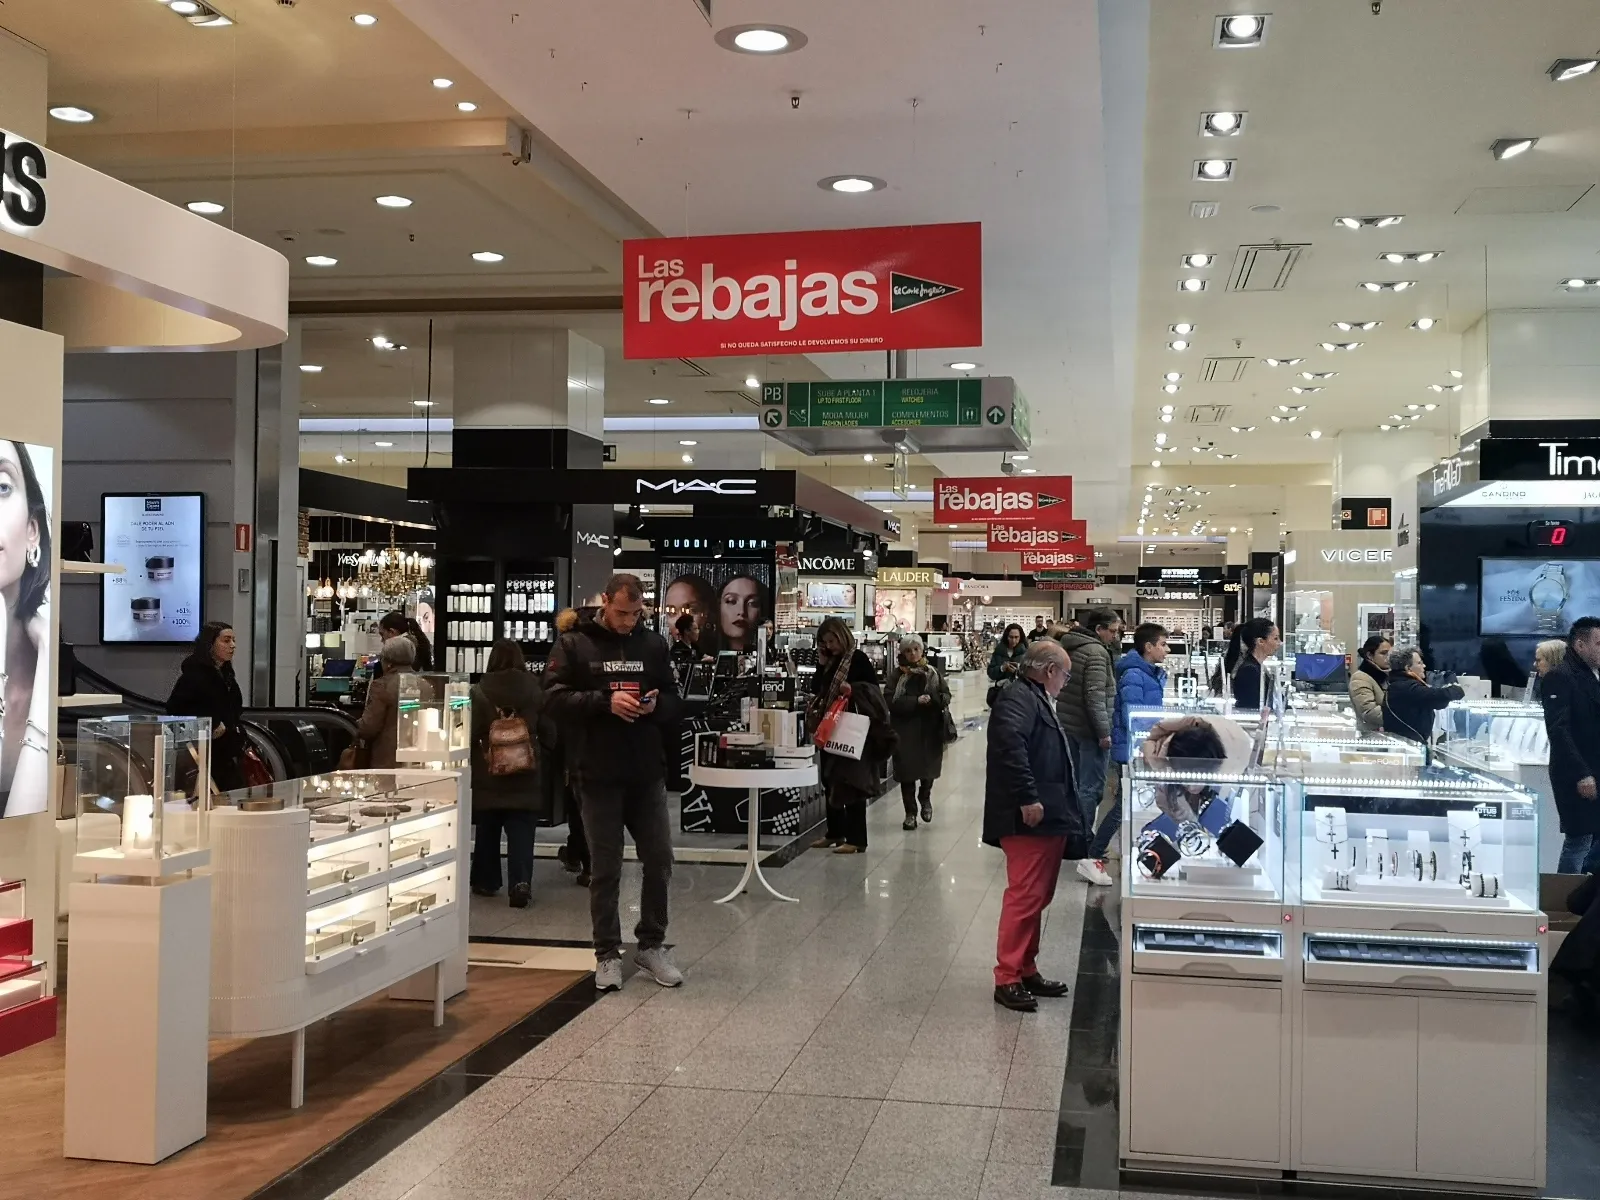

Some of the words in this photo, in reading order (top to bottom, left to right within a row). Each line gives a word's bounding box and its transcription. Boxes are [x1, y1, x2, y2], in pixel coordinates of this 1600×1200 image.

[0, 131, 47, 227] S
[638, 255, 684, 278] Las
[638, 259, 879, 331] rebajas
[764, 387, 782, 401] PB
[844, 389, 870, 397] PLANTA
[891, 410, 949, 418] COMPLEMENTOS
[1538, 442, 1600, 476] Tim
[939, 484, 958, 493] Las
[939, 487, 1034, 515] rebajas
[888, 520, 900, 534] MAC
[991, 523, 1005, 531] Las
[576, 530, 610, 549] MAC
[991, 526, 1059, 546] rebajas
[1551, 527, 1566, 544] 0
[1023, 552, 1074, 567] rebajas
[883, 572, 930, 583] LAUDER
[1136, 588, 1159, 596] CAJA
[825, 740, 855, 754] BIMBA
[1472, 806, 1498, 814] LOTUS
